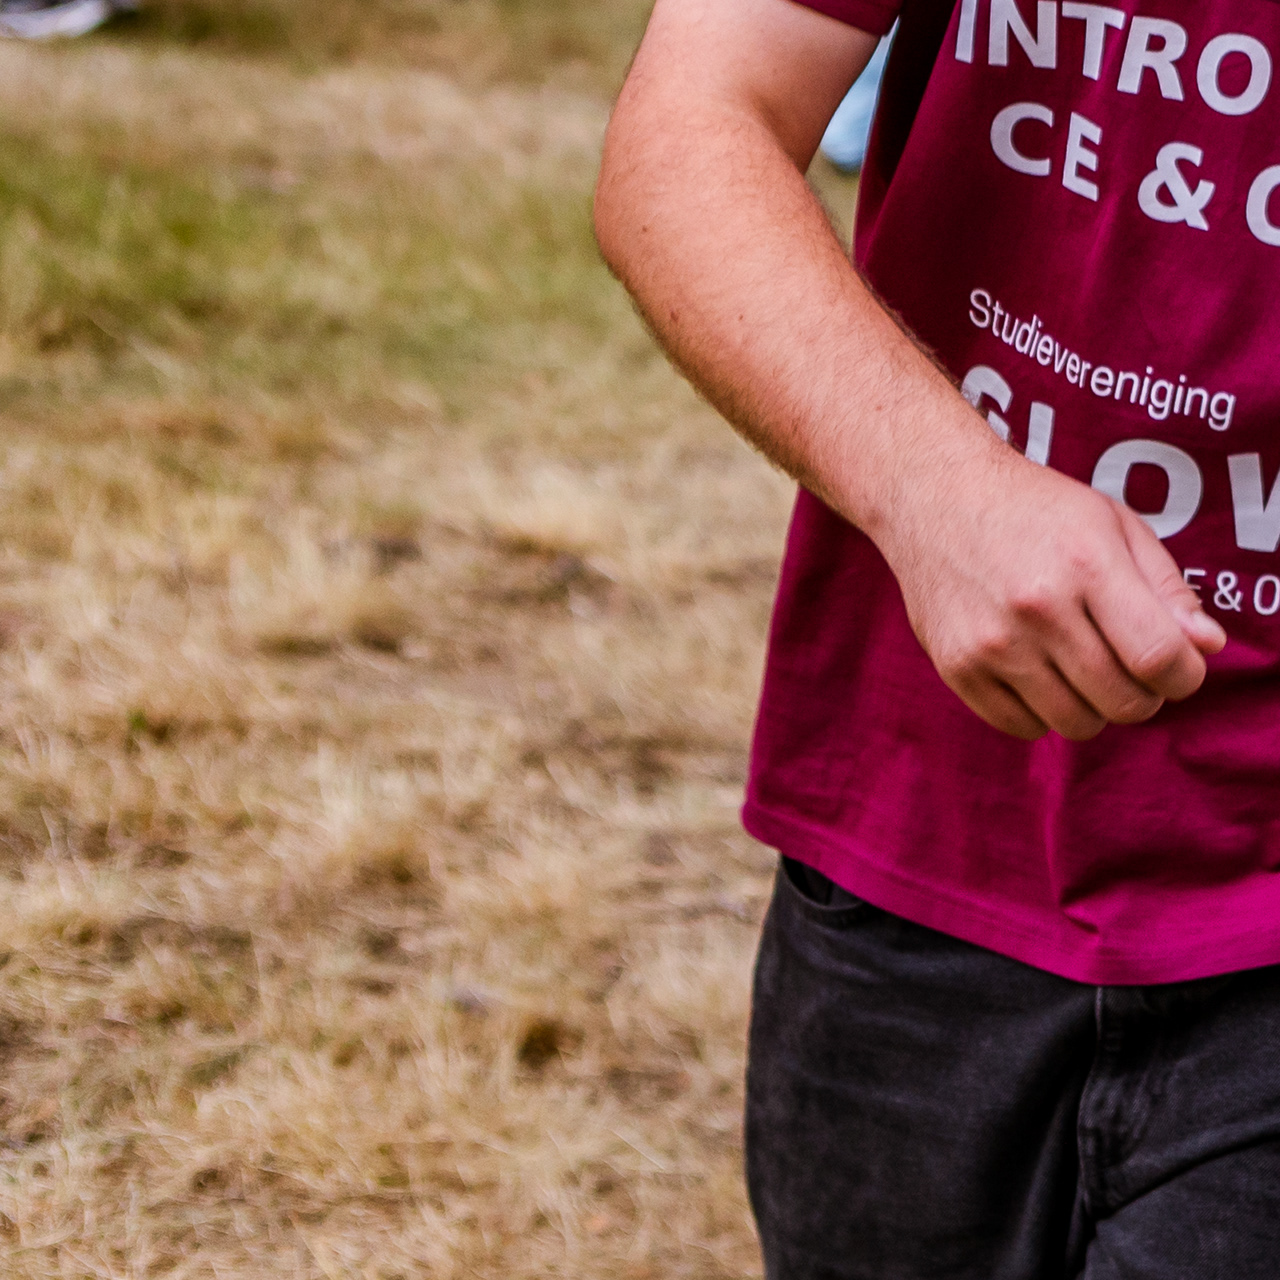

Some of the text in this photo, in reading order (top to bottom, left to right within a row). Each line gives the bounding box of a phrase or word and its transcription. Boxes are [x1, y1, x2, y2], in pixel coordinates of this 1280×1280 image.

[989, 102, 1102, 201] CE
[1137, 141, 1216, 231] &
[968, 288, 1236, 431] Studievereniging
[1213, 570, 1243, 612] &
